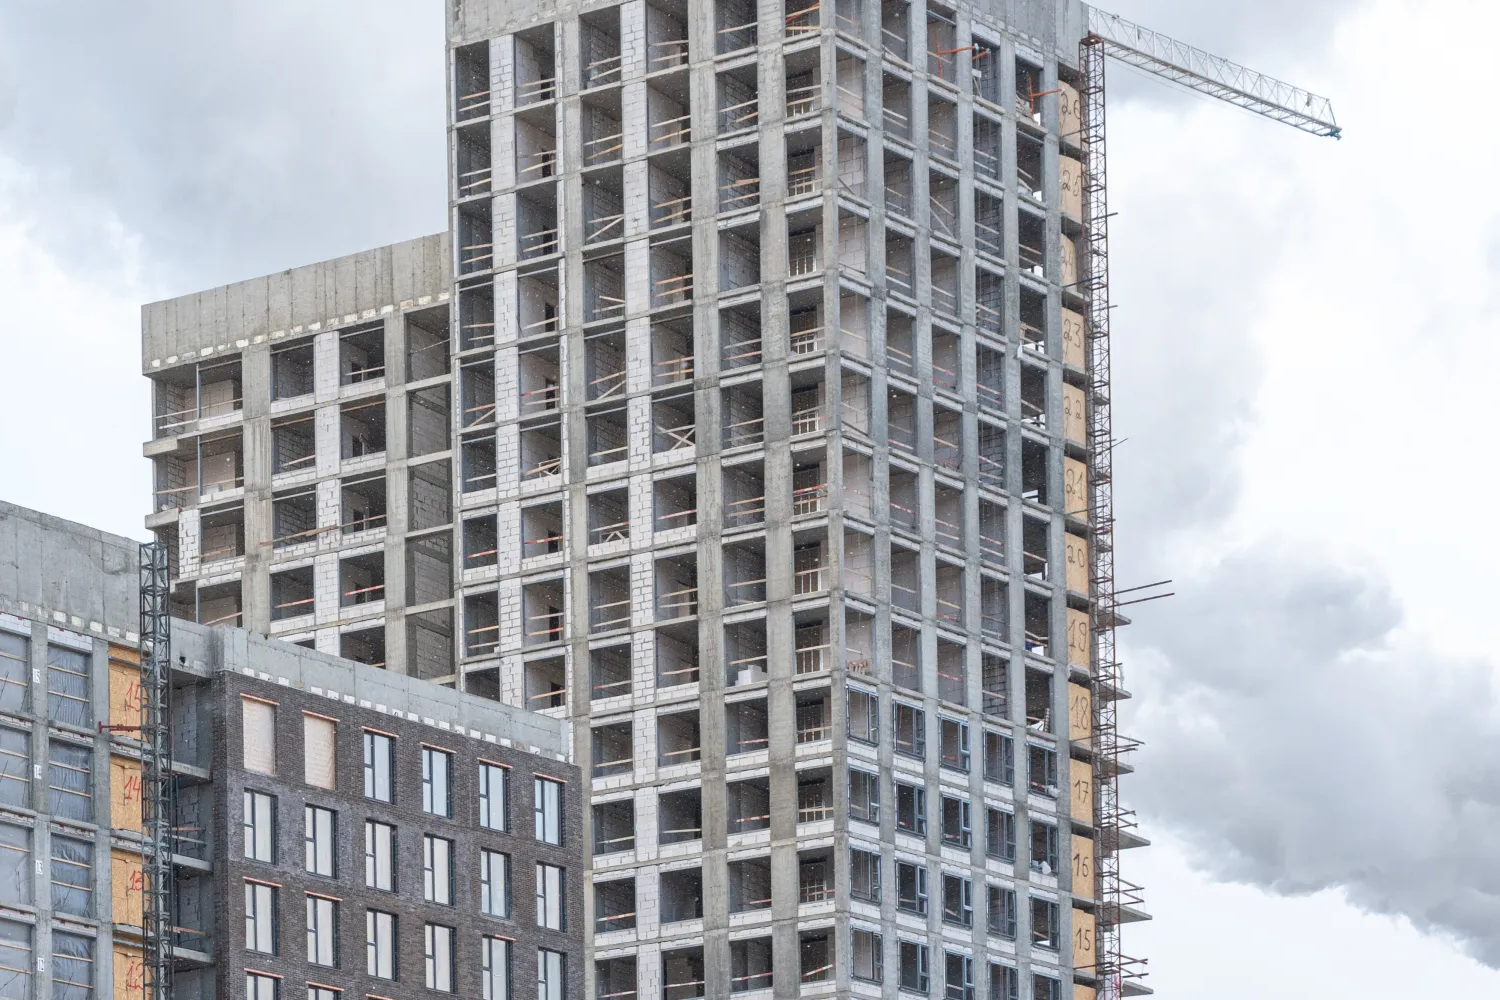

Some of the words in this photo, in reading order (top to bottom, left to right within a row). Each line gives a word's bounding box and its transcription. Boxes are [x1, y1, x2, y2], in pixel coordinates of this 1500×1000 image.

[1063, 319, 1081, 348] 23
[1064, 396, 1082, 420] 22
[1066, 468, 1084, 501] 21
[1067, 545, 1085, 567] 20
[1068, 619, 1087, 652] 19
[1071, 696, 1088, 729] 18
[124, 776, 141, 802] 14
[1074, 779, 1089, 804] 17
[1073, 853, 1089, 877] 16
[129, 870, 143, 891] 13
[1076, 927, 1091, 951] 15
